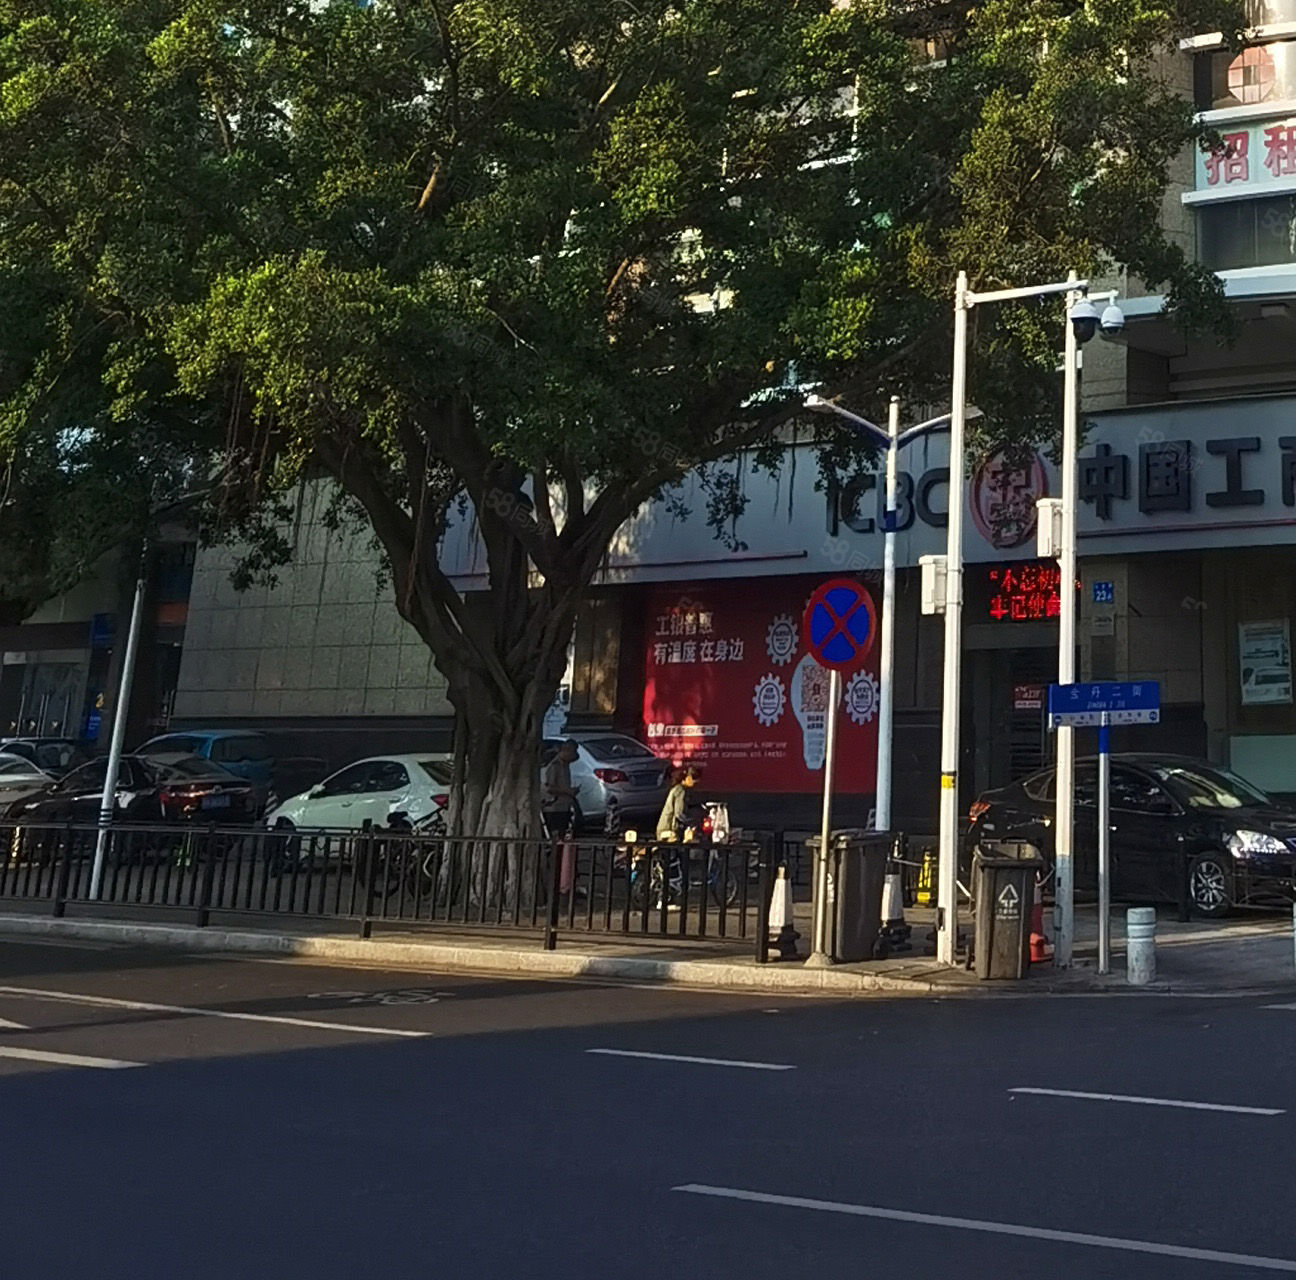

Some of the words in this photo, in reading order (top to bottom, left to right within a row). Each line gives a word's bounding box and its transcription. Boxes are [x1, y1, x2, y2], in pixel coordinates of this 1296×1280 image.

[655, 612, 713, 636] 工银普惠
[654, 640, 696, 665] 有温度
[699, 638, 744, 662] 在身边
